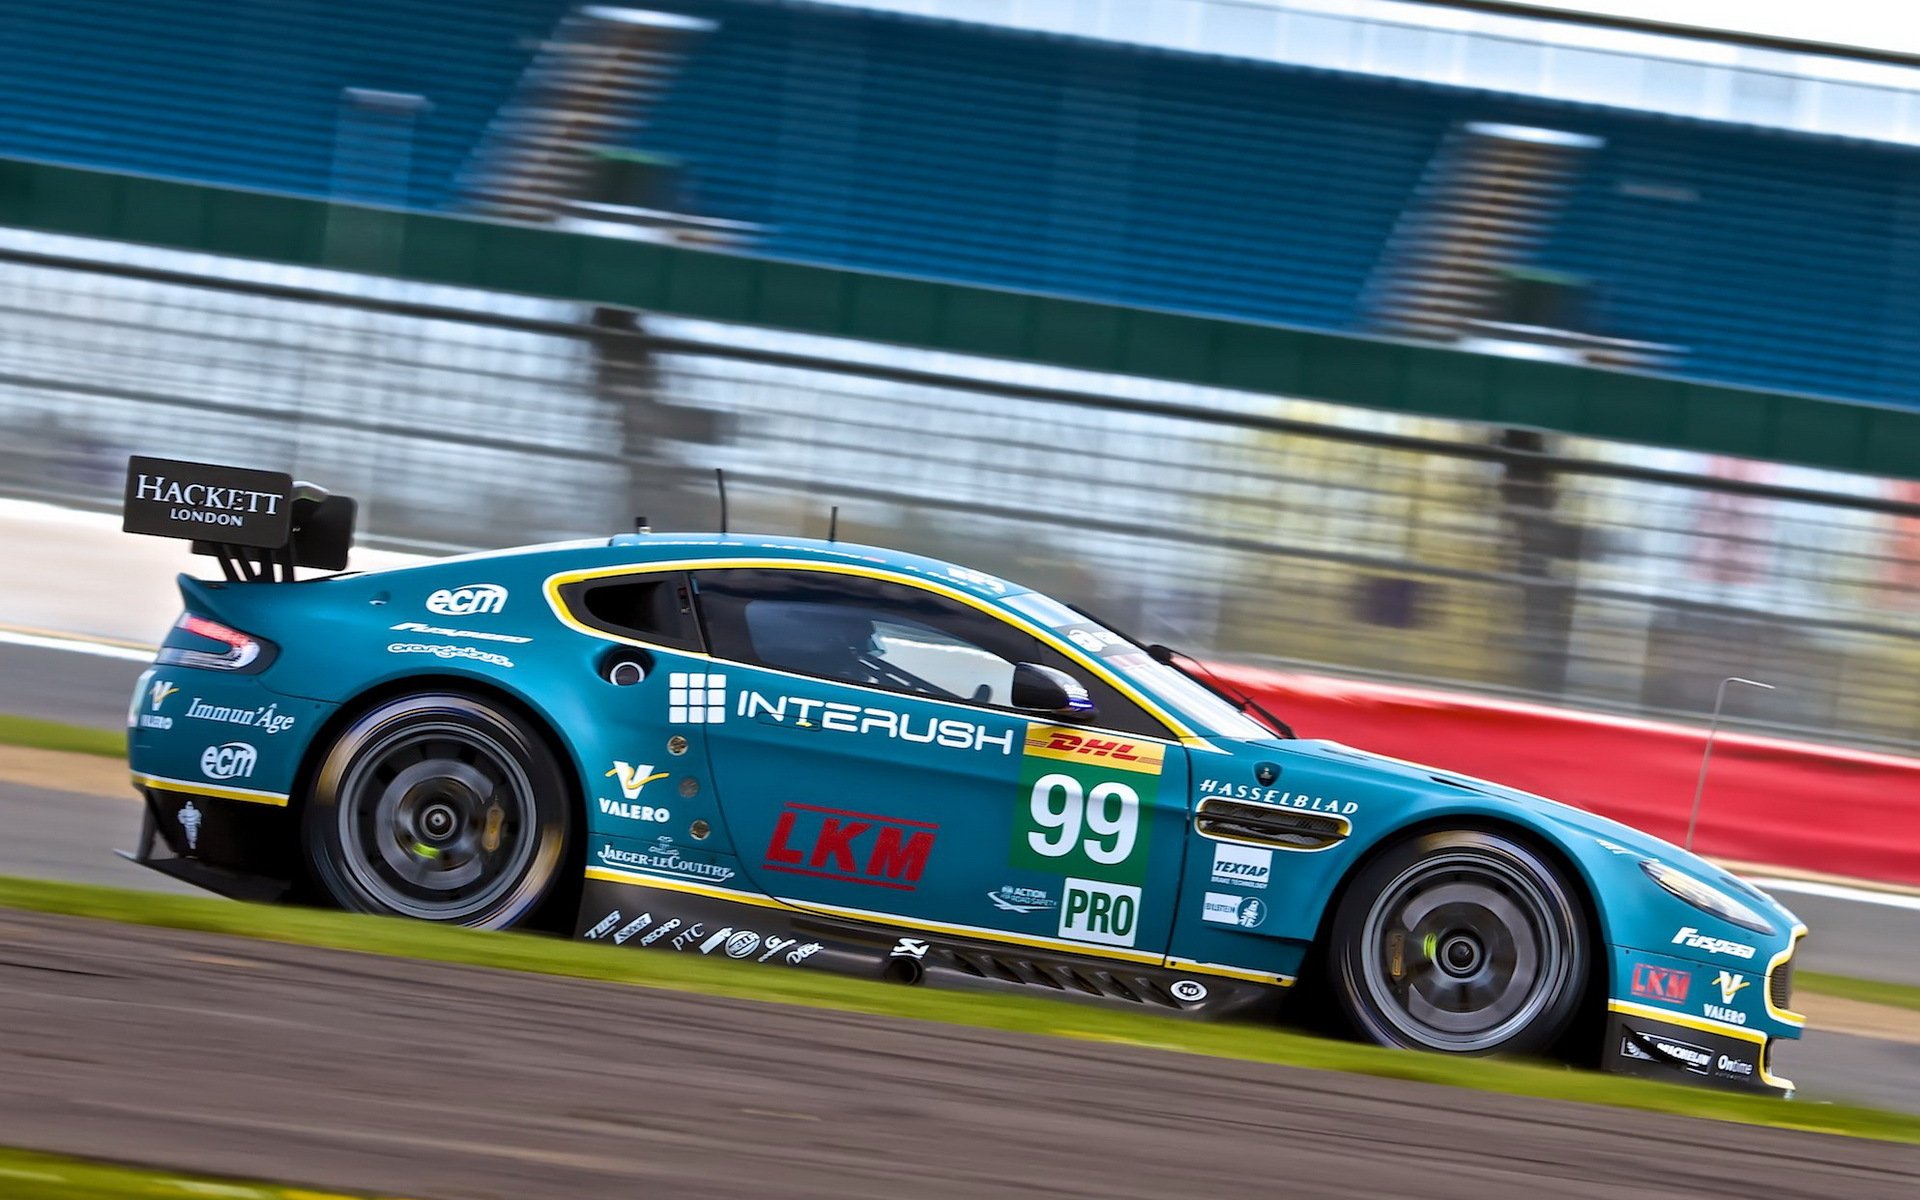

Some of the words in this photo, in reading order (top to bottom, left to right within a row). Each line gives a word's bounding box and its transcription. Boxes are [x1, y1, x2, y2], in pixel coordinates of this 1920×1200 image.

[136, 474, 283, 515] HACKETT
[170, 508, 243, 527] LONDON
[426, 584, 508, 615] ecm
[737, 690, 1014, 755] INTERUSH
[201, 742, 257, 779] ecm
[1047, 732, 1139, 761] DHL
[599, 798, 670, 823] VALERO
[1200, 779, 1358, 814] HASSELBLAD
[1028, 774, 1139, 864] 99
[765, 811, 936, 881] LKM
[1014, 887, 1046, 899] ACTION
[1064, 889, 1134, 936] PRO
[640, 918, 681, 947] RECARO
[1632, 967, 1689, 1000] LKM
[1704, 1003, 1746, 1025] VALERO
